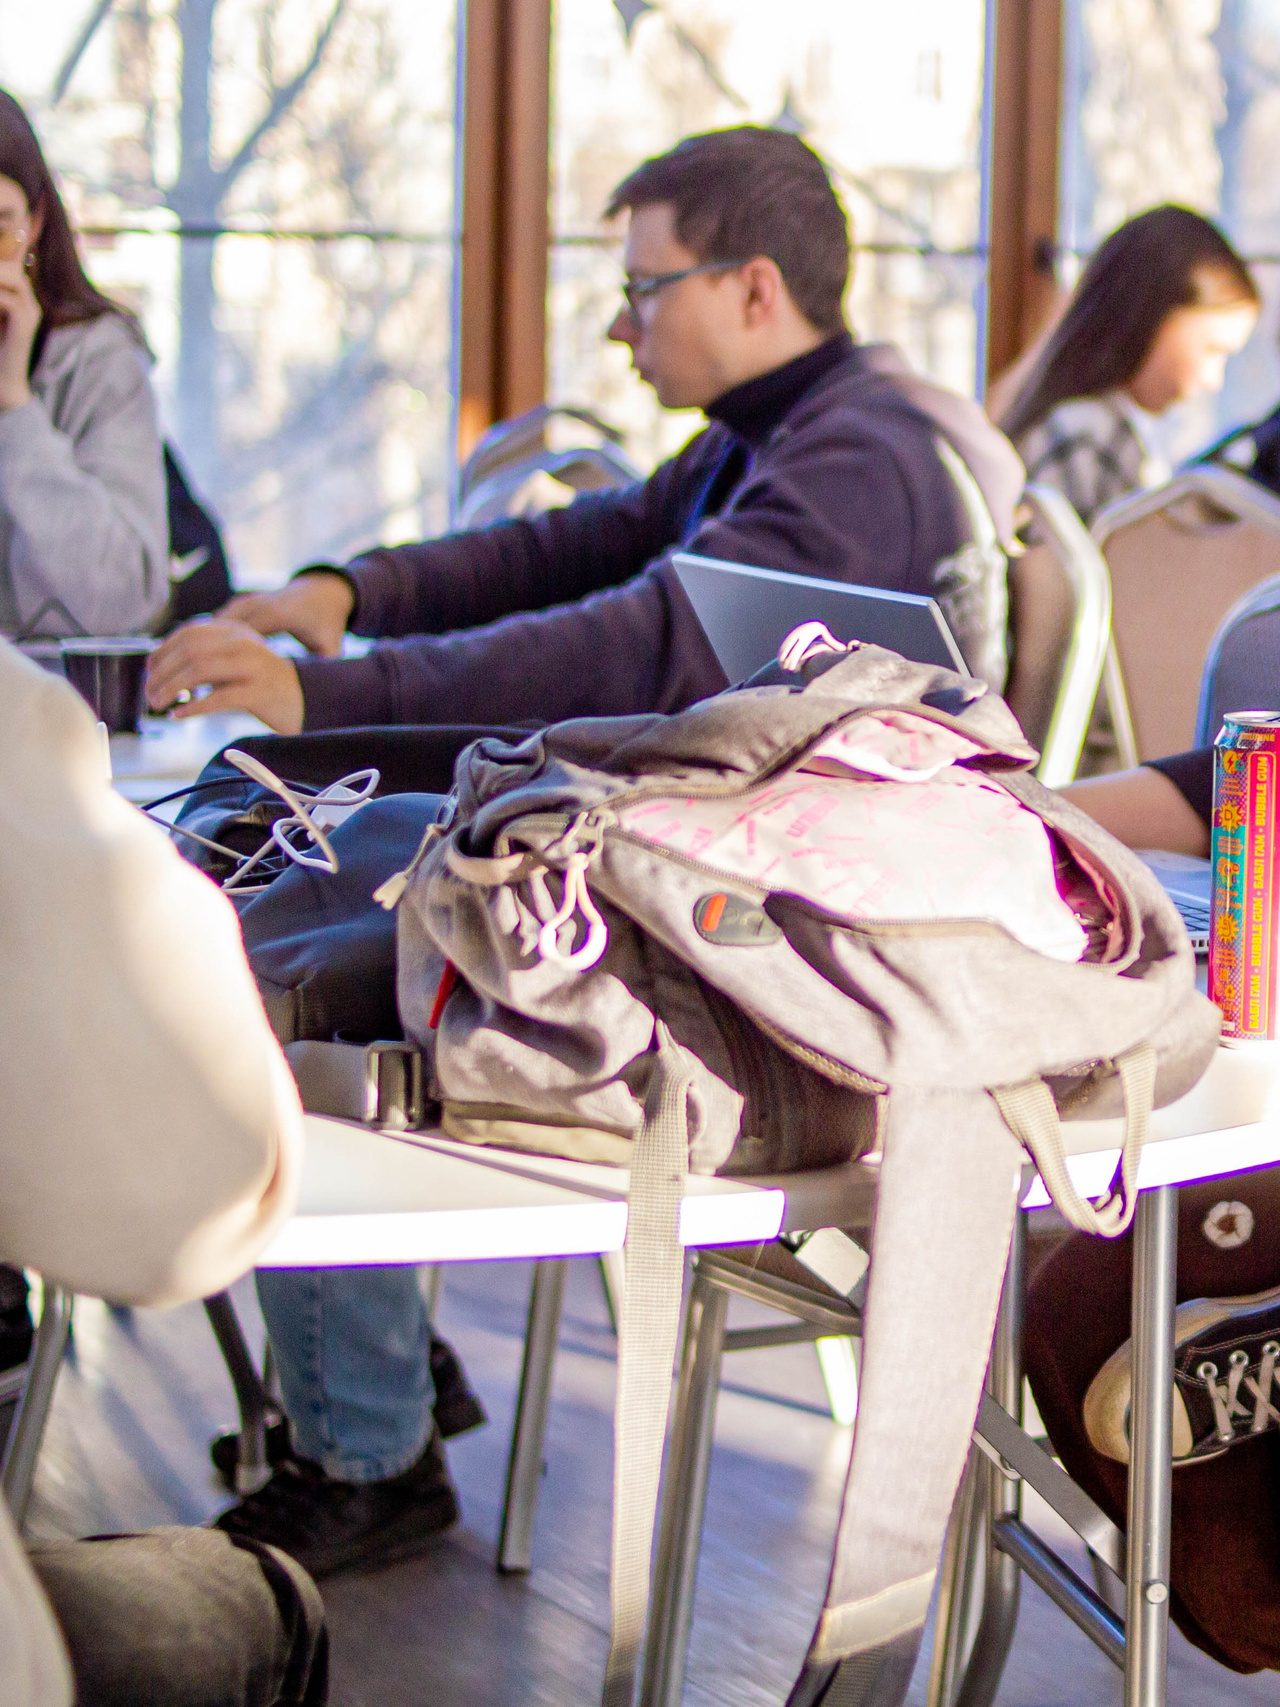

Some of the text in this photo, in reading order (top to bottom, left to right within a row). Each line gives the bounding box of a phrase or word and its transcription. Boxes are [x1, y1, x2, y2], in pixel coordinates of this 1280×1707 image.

[1249, 757, 1267, 1028] БАБЛ ГАМ BUBBLE GUM БАБЛ ГАМ BUBBLE GUM
